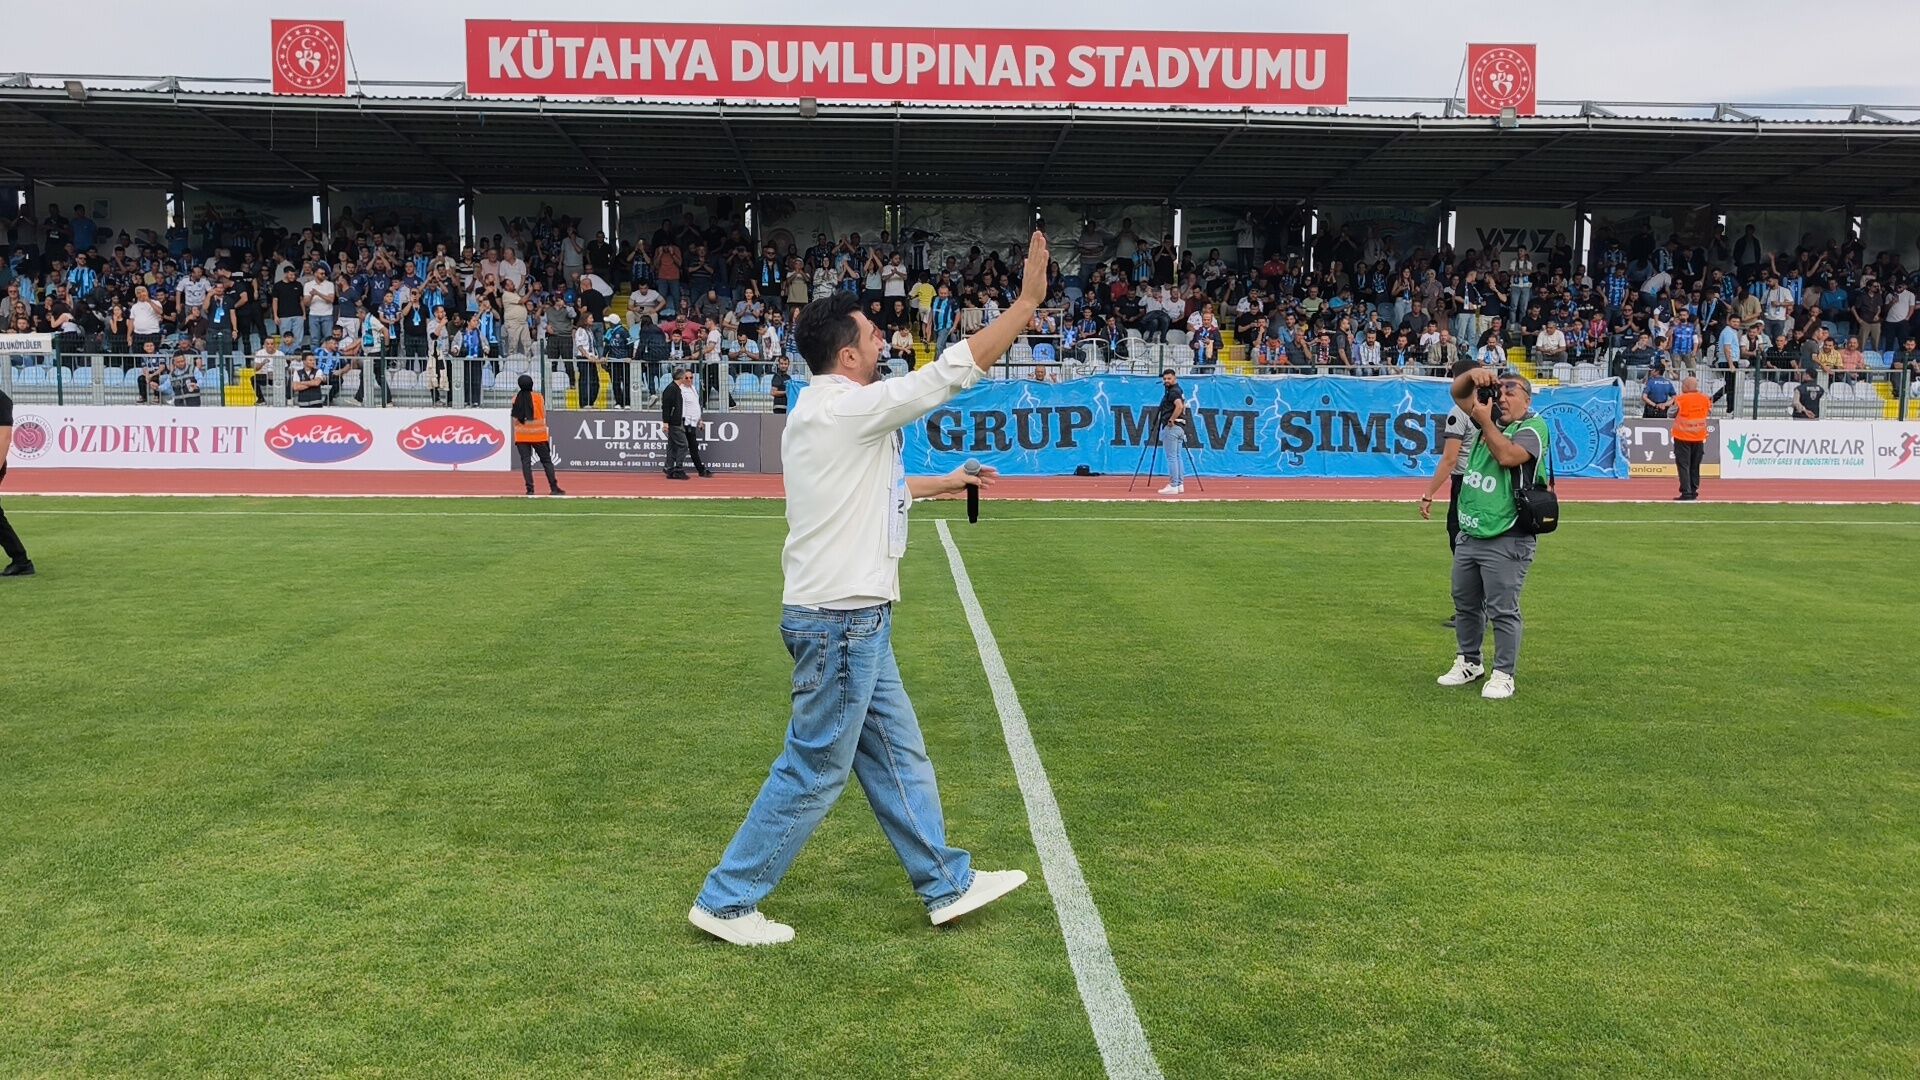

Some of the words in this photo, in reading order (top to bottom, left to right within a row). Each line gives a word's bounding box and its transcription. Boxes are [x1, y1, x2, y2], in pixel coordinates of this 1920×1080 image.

[488, 29, 719, 81] KÜTAHYA
[731, 40, 1056, 88] DUMLUPINAR
[1066, 43, 1327, 91] STADYUMU
[58, 417, 200, 454] ÖZDEMİR
[211, 425, 249, 454] ET
[270, 424, 368, 449] Sultan
[402, 425, 500, 450] Sultan
[926, 404, 1094, 453] GRUP
[604, 442, 631, 450] OTEL
[1746, 433, 1865, 458] ÖZÇINARLAR
